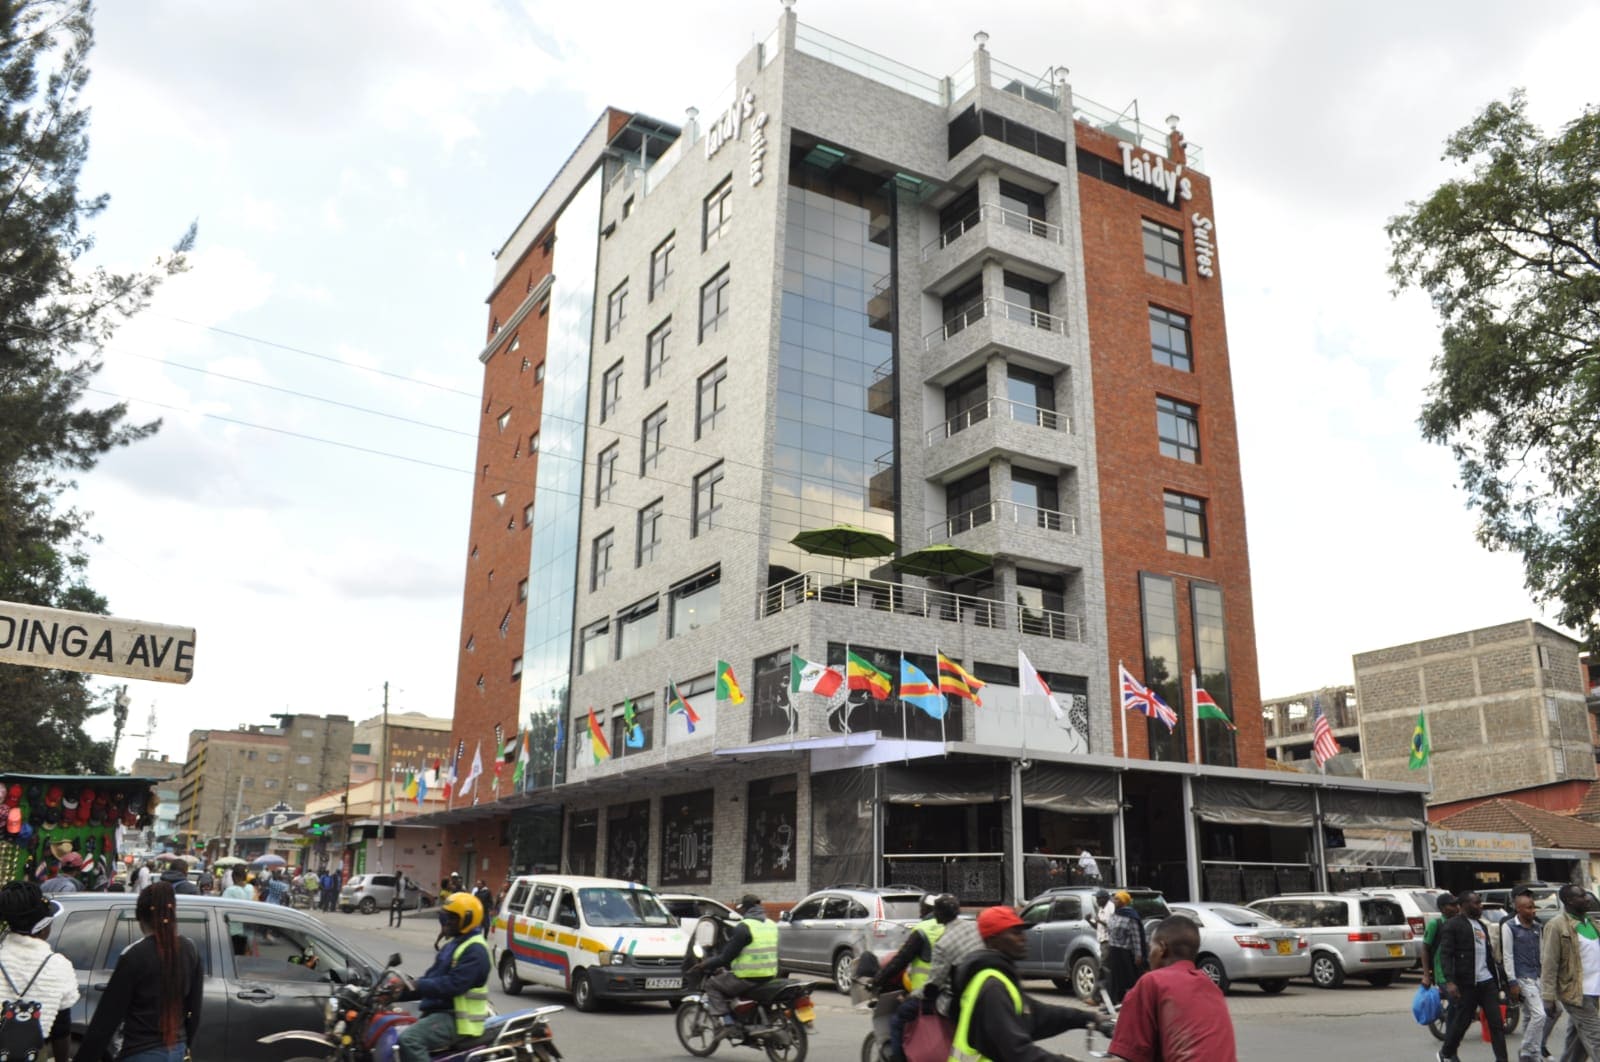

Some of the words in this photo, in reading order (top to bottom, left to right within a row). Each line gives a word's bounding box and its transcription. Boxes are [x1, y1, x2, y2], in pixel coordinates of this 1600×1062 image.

[750, 111, 768, 187] Suites
[1118, 141, 1192, 204] Taidy's
[1191, 212, 1214, 278] Suites
[126, 634, 194, 672] AVE
